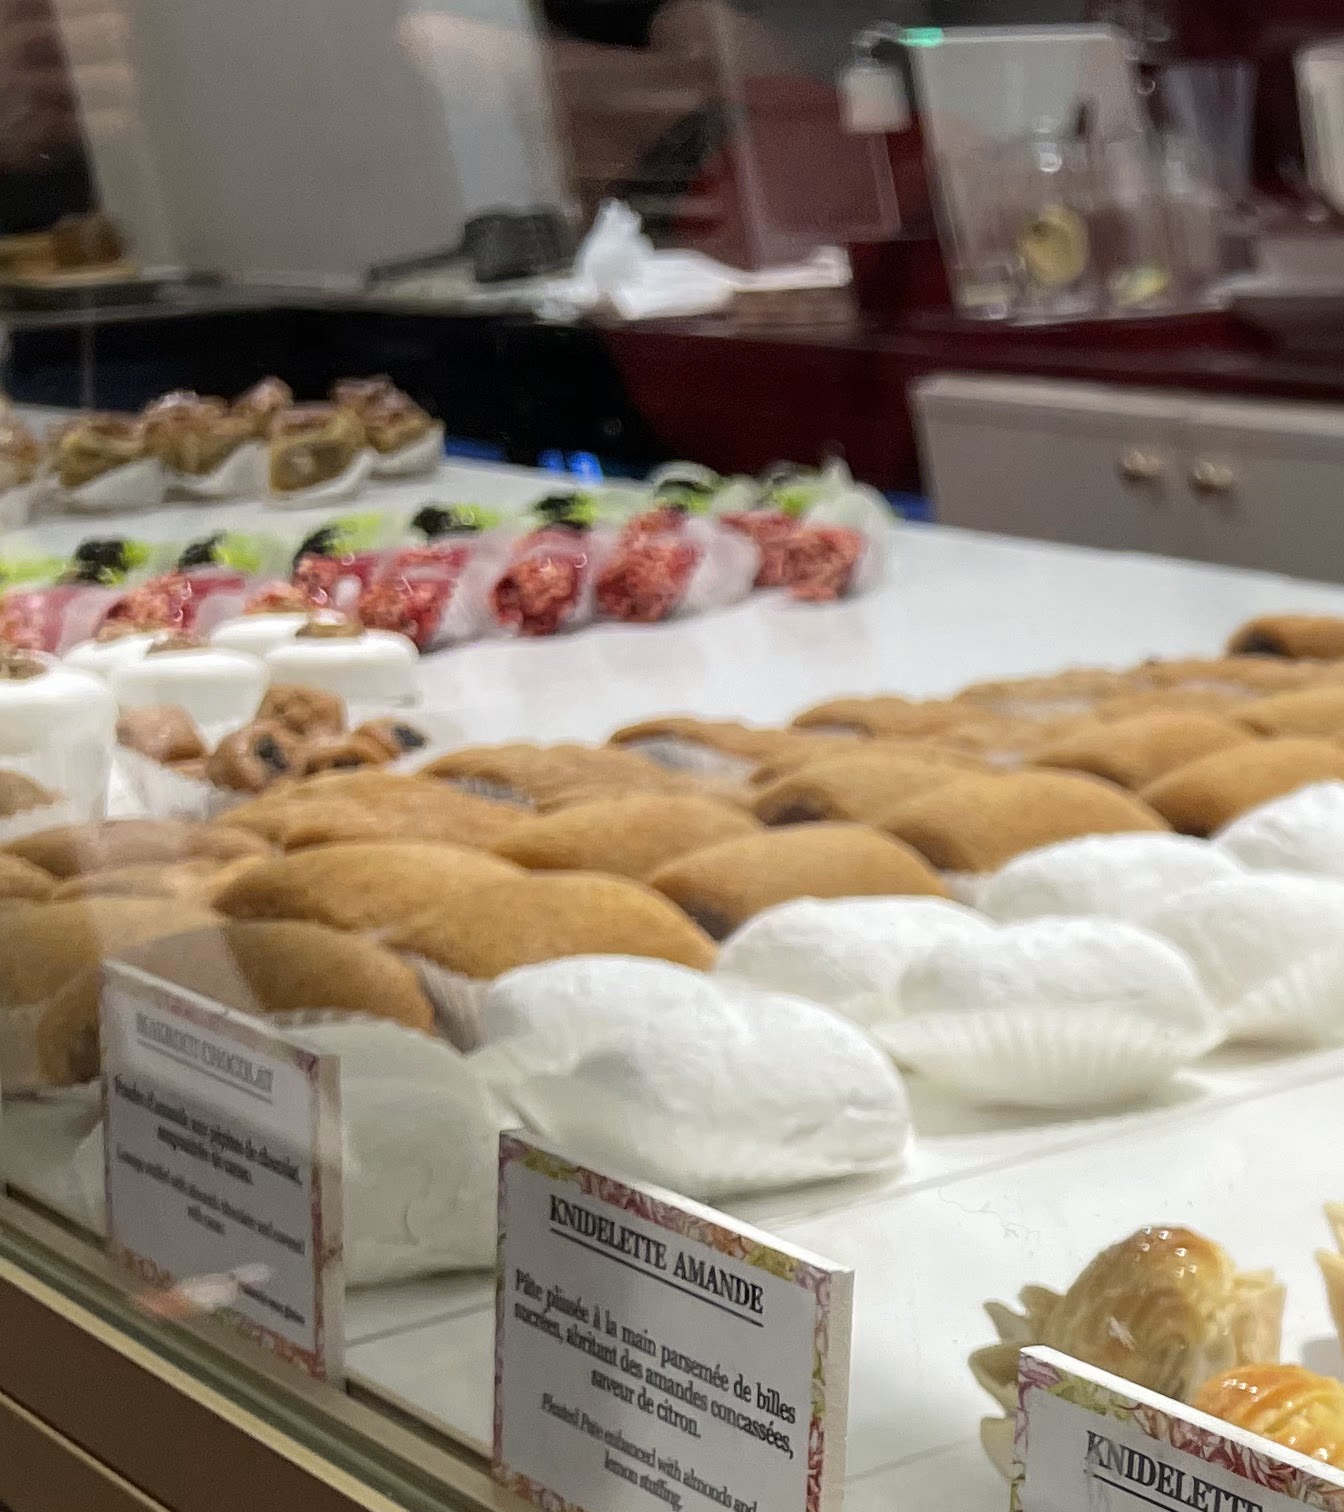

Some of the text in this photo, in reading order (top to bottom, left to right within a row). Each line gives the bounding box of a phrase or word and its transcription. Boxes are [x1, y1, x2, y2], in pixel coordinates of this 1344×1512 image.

[550, 1194, 763, 1314] KNIDELETTE AMANDE
[605, 1310, 618, 1338] la
[621, 1326, 657, 1357] main
[660, 1345, 729, 1392] parsemée
[733, 1373, 752, 1402] de
[756, 1382, 796, 1424] billes
[619, 1348, 644, 1380] des
[645, 1367, 708, 1411] amandes
[710, 1399, 794, 1460] concassées,
[637, 1385, 655, 1414] de
